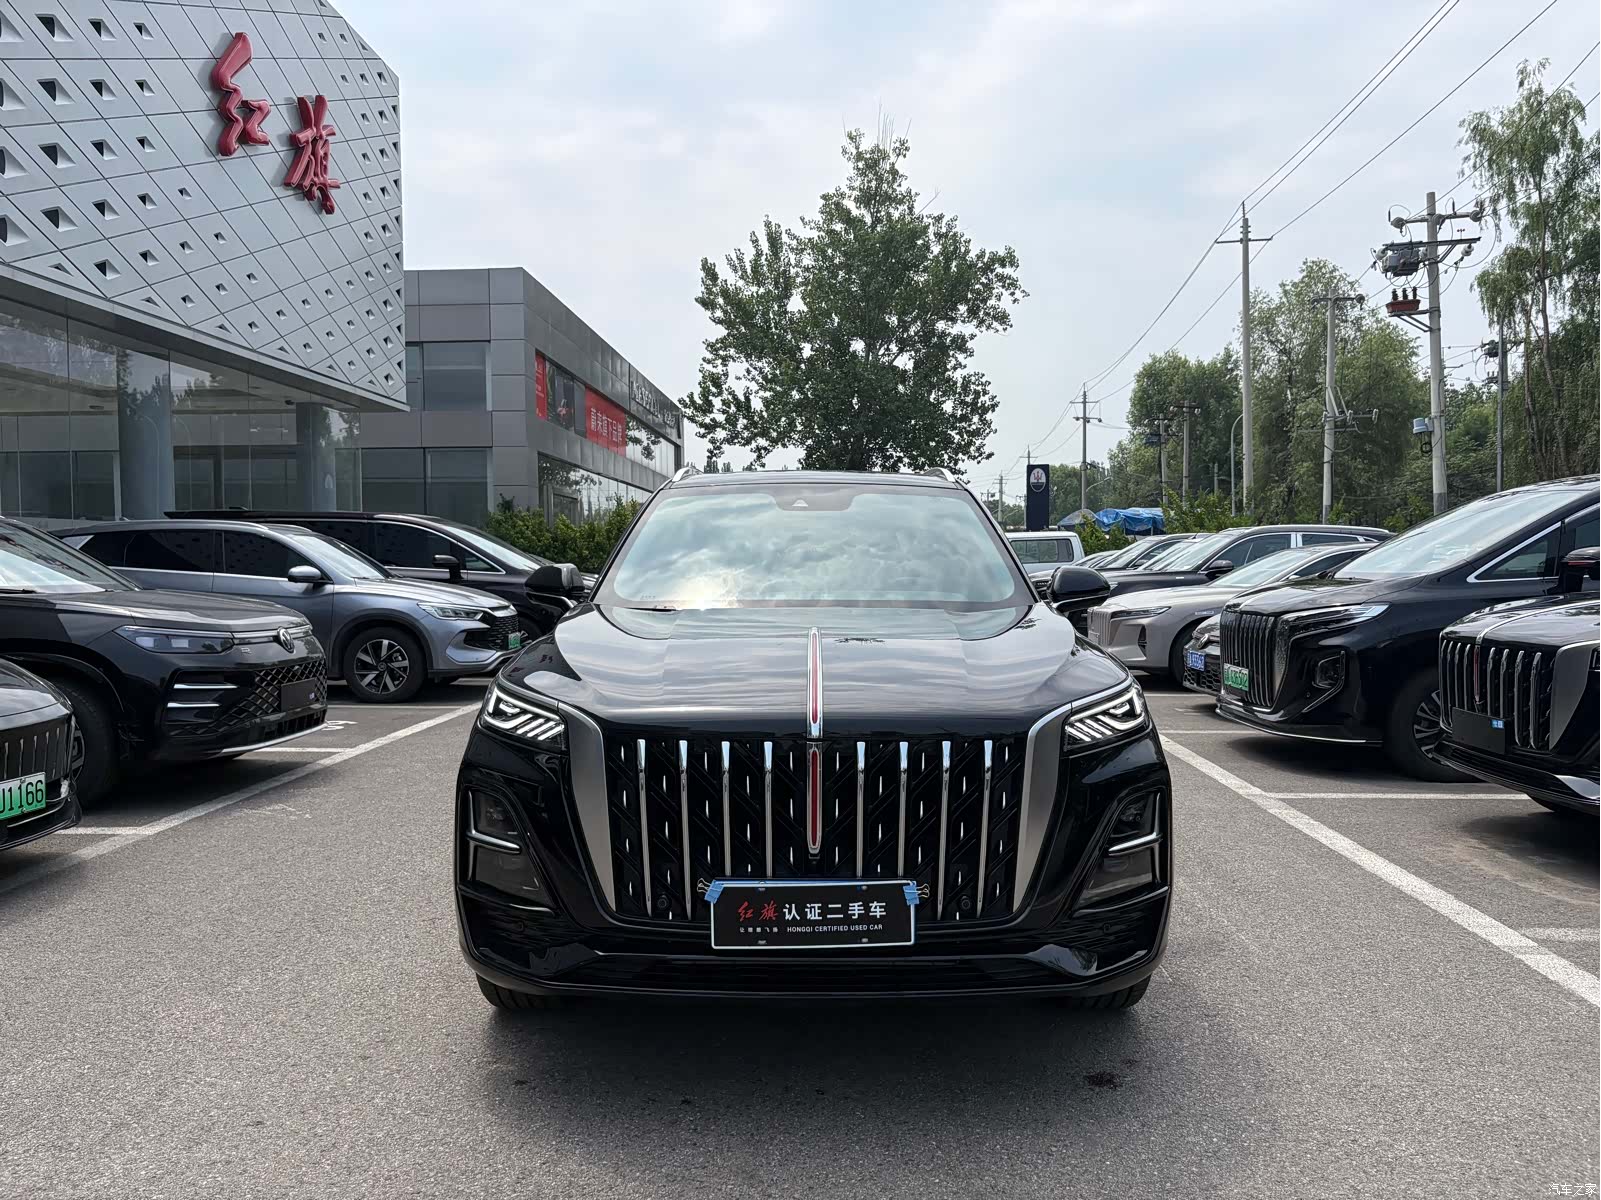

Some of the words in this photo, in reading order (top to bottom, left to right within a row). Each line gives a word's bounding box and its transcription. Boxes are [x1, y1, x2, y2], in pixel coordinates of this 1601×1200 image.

[209, 32, 341, 215] 红旗
[783, 901, 887, 921] 认证二手车
